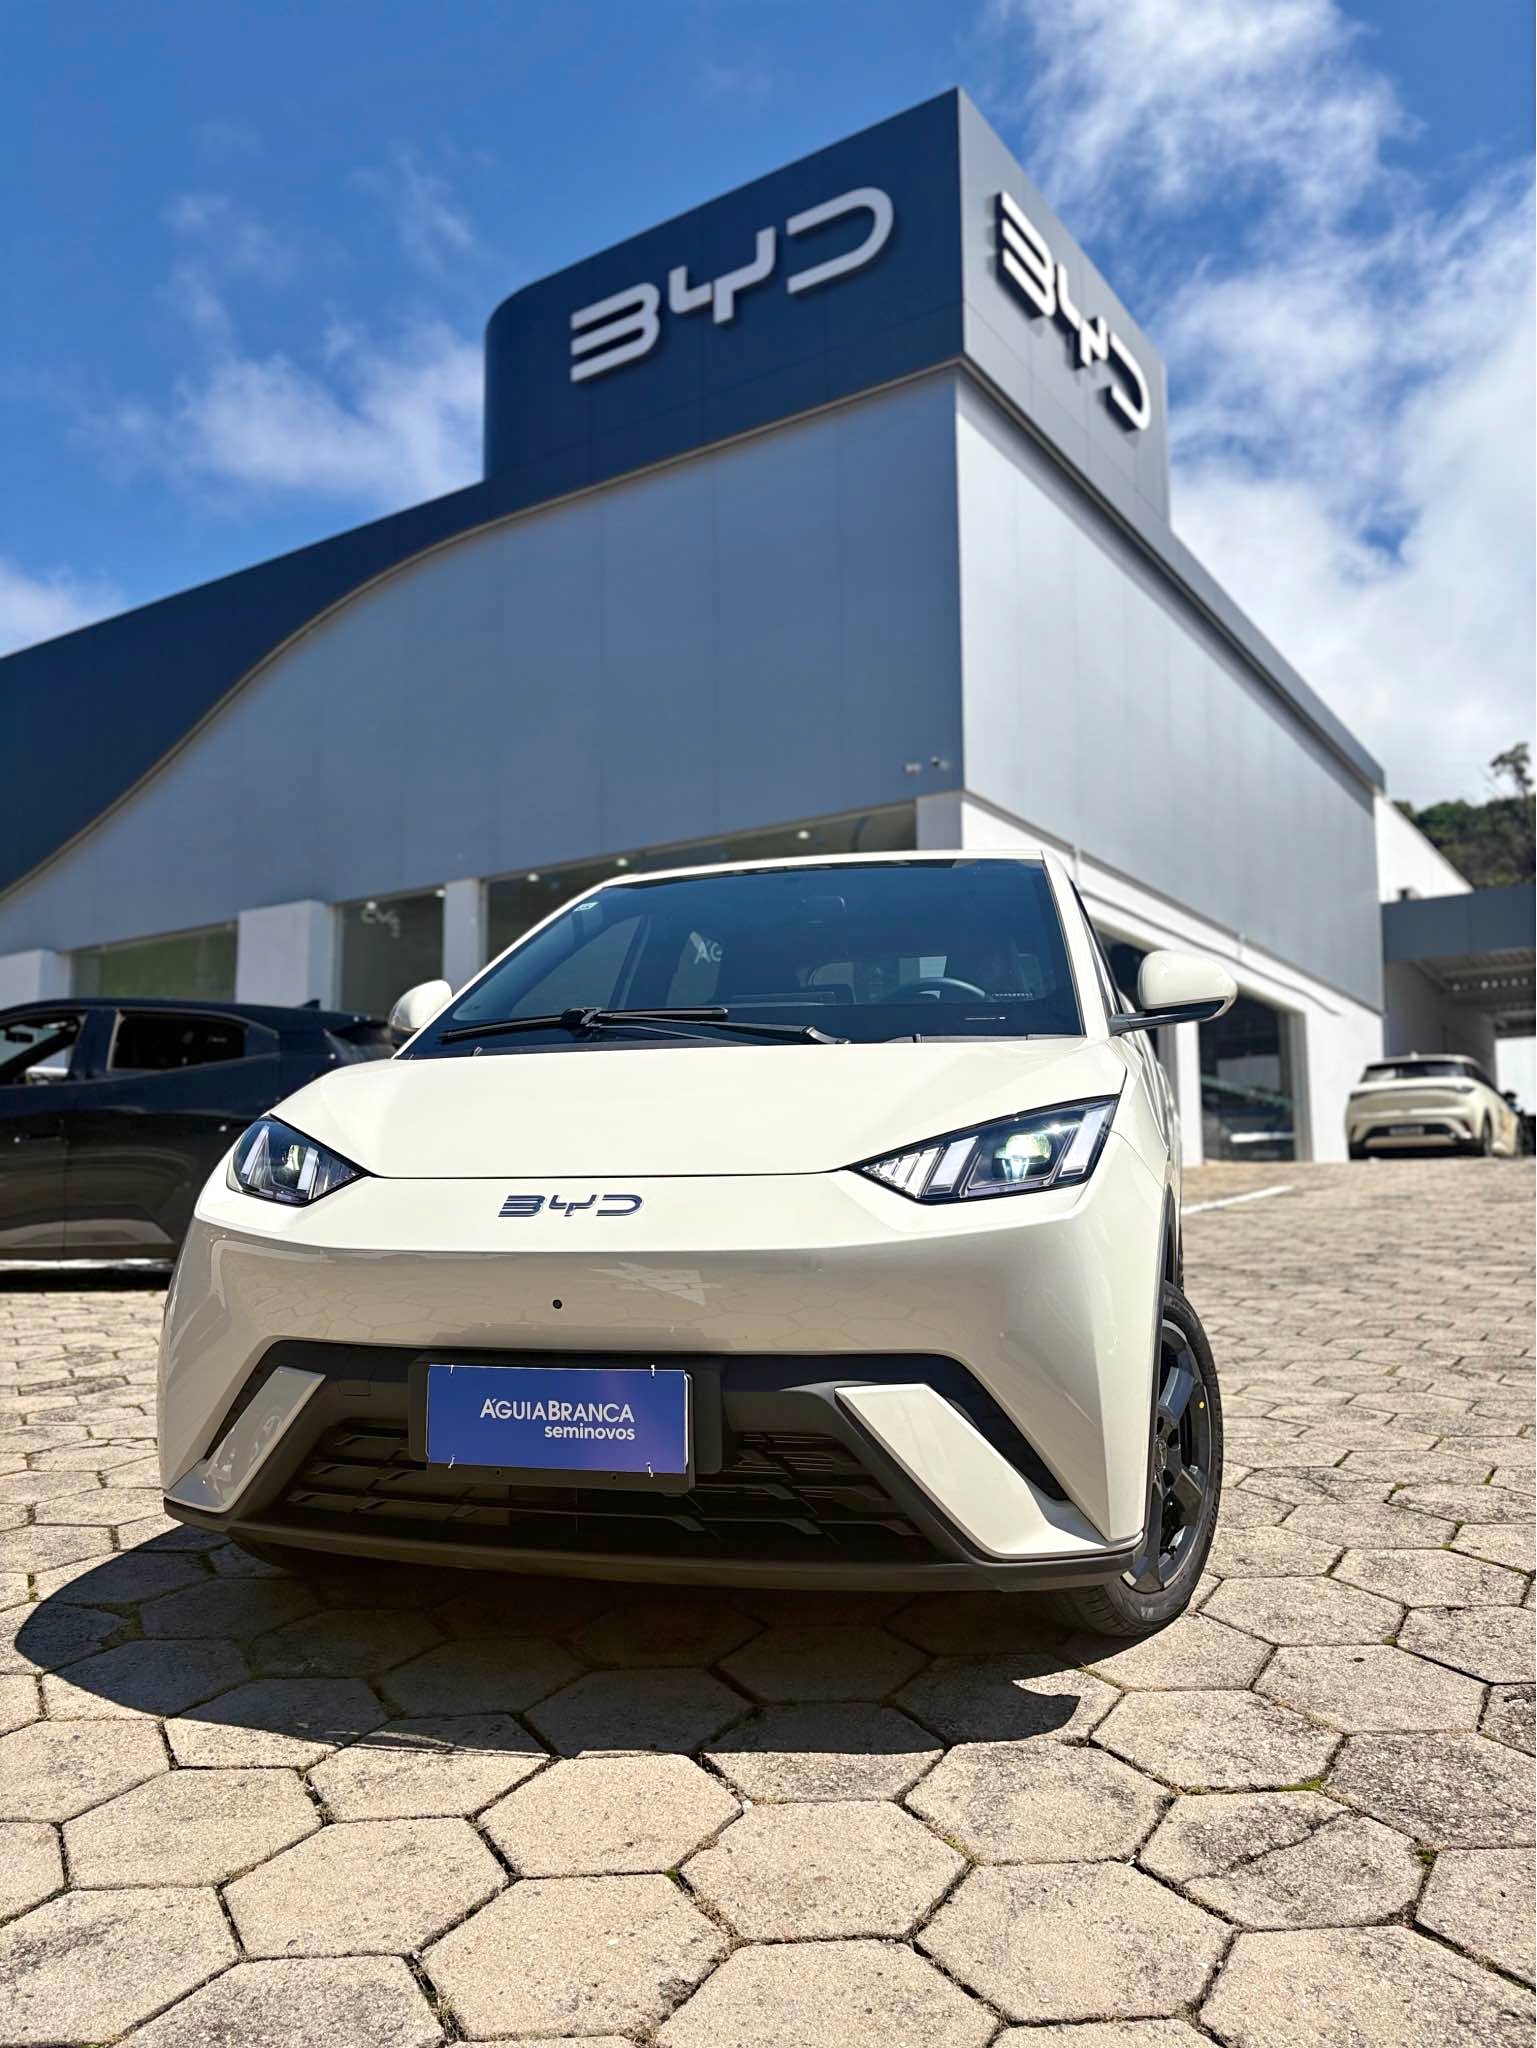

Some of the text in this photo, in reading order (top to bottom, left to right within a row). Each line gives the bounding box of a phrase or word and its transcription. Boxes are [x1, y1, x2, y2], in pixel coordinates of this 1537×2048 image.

[570, 187, 894, 382] BYD
[1001, 191, 1150, 431] BYD
[498, 1194, 645, 1217] BYD
[544, 1423, 636, 1440] seminovos
